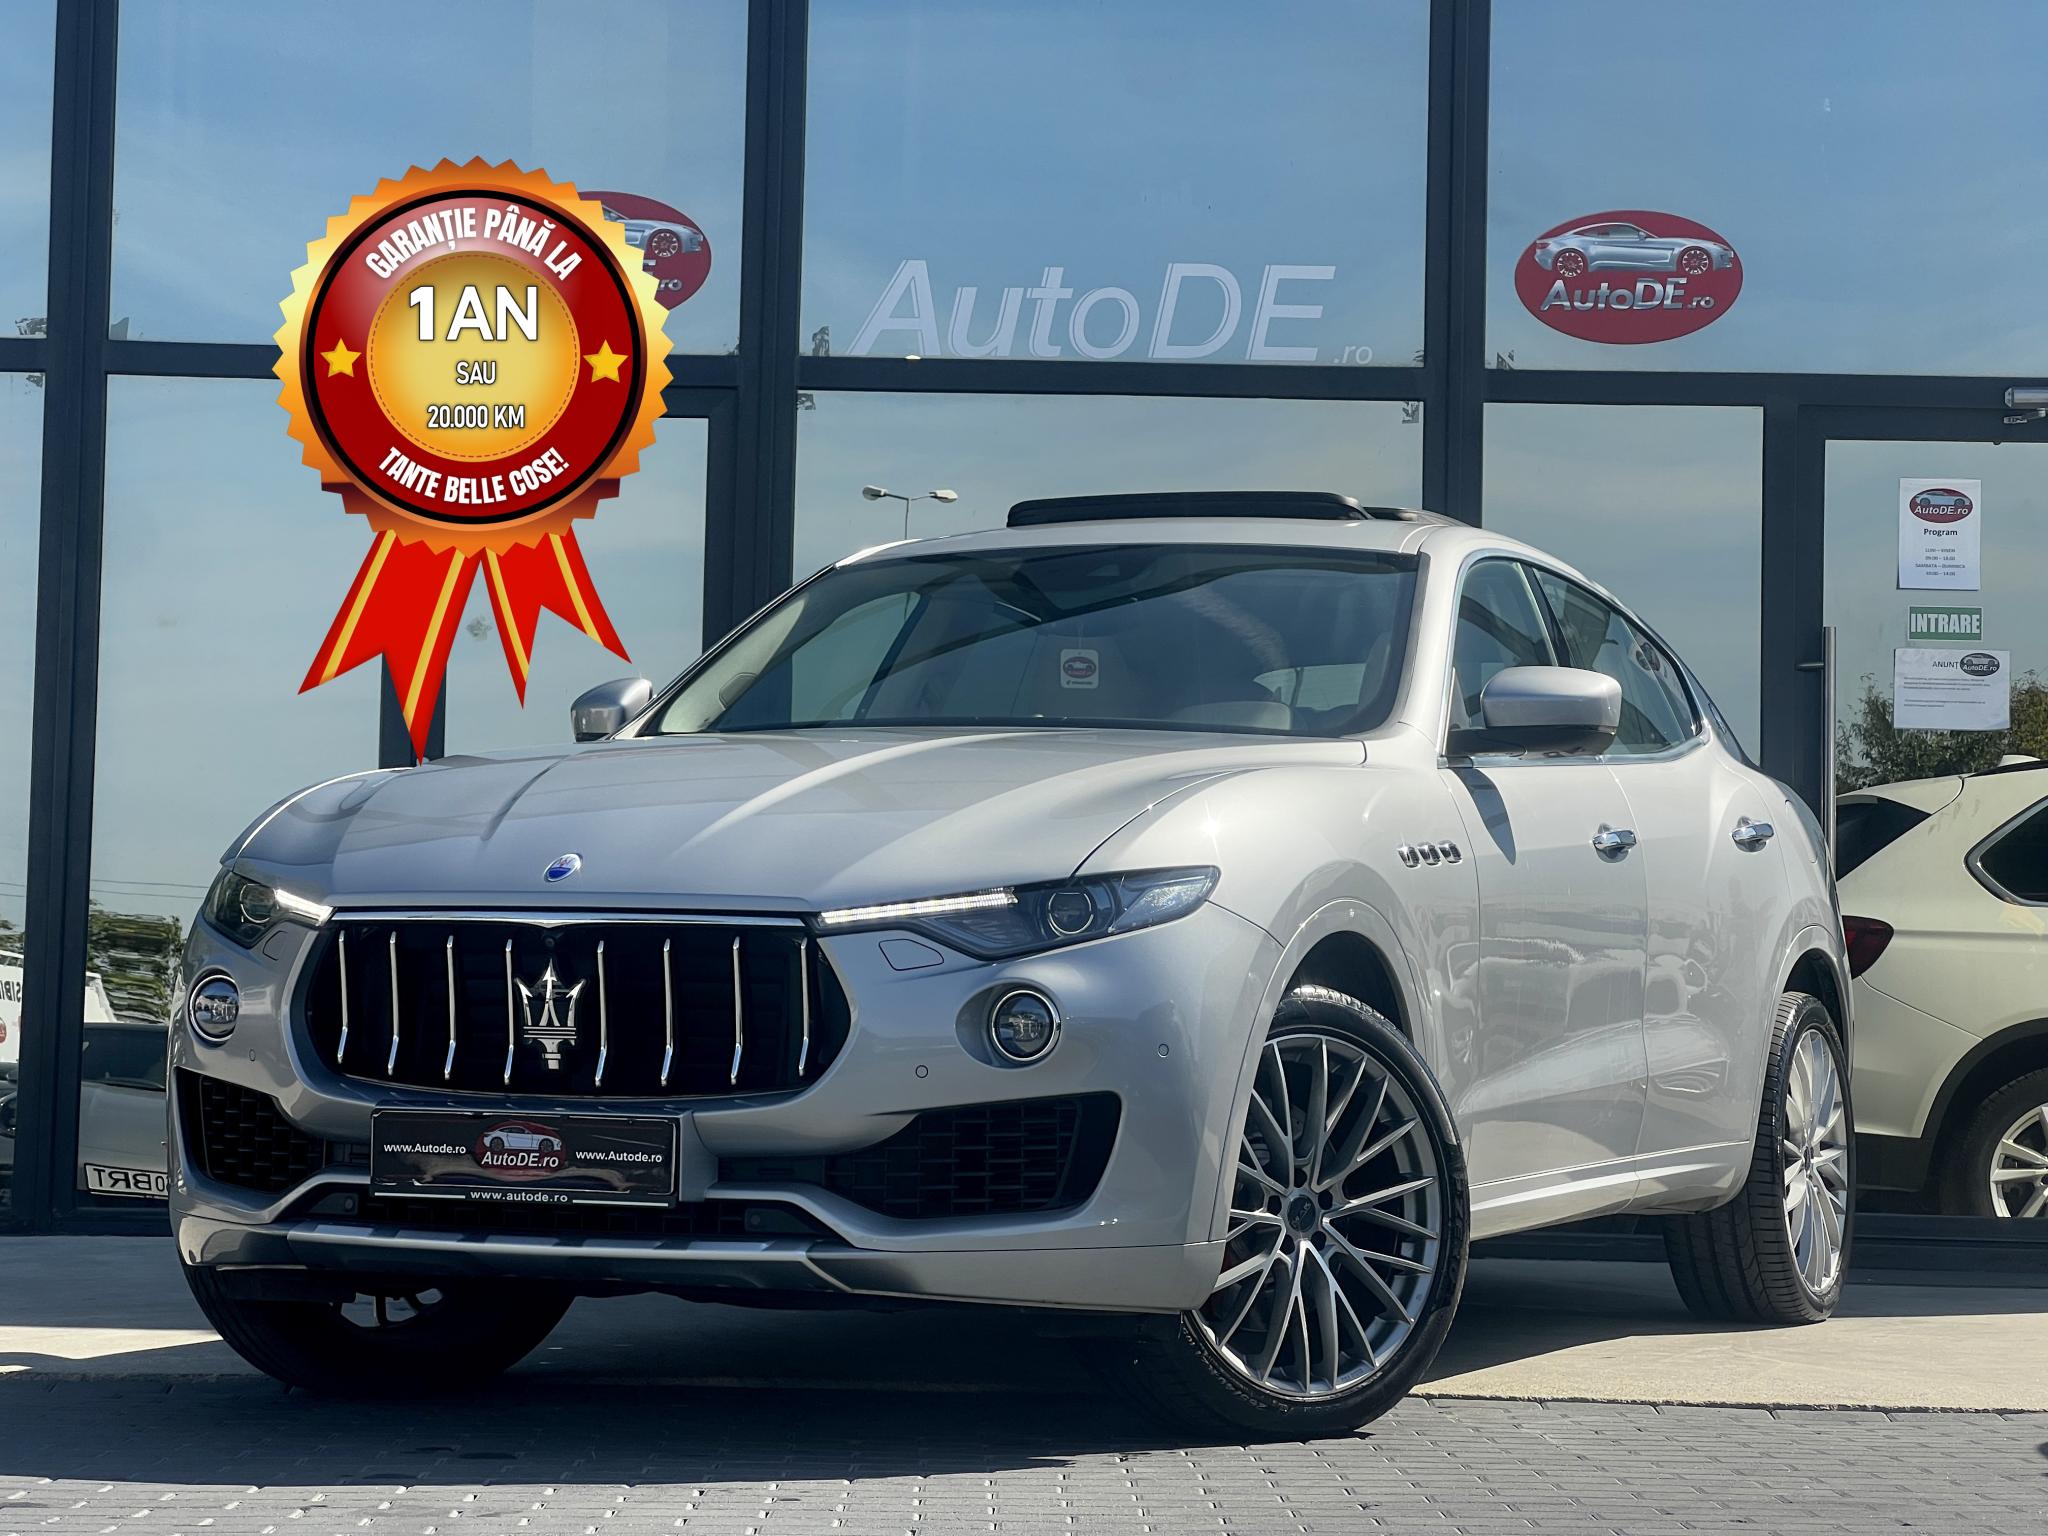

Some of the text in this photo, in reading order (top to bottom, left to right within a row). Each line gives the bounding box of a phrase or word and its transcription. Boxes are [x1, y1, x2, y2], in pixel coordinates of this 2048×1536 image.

[1923, 528, 1958, 537] Program
[1910, 613, 1981, 633] INTRARE
[383, 1142, 467, 1154] www.Autode.ro
[481, 1151, 559, 1168] AutoDE.ro
[575, 1150, 663, 1163] www.Autode.ro
[470, 1190, 568, 1203] www.autode.ro
